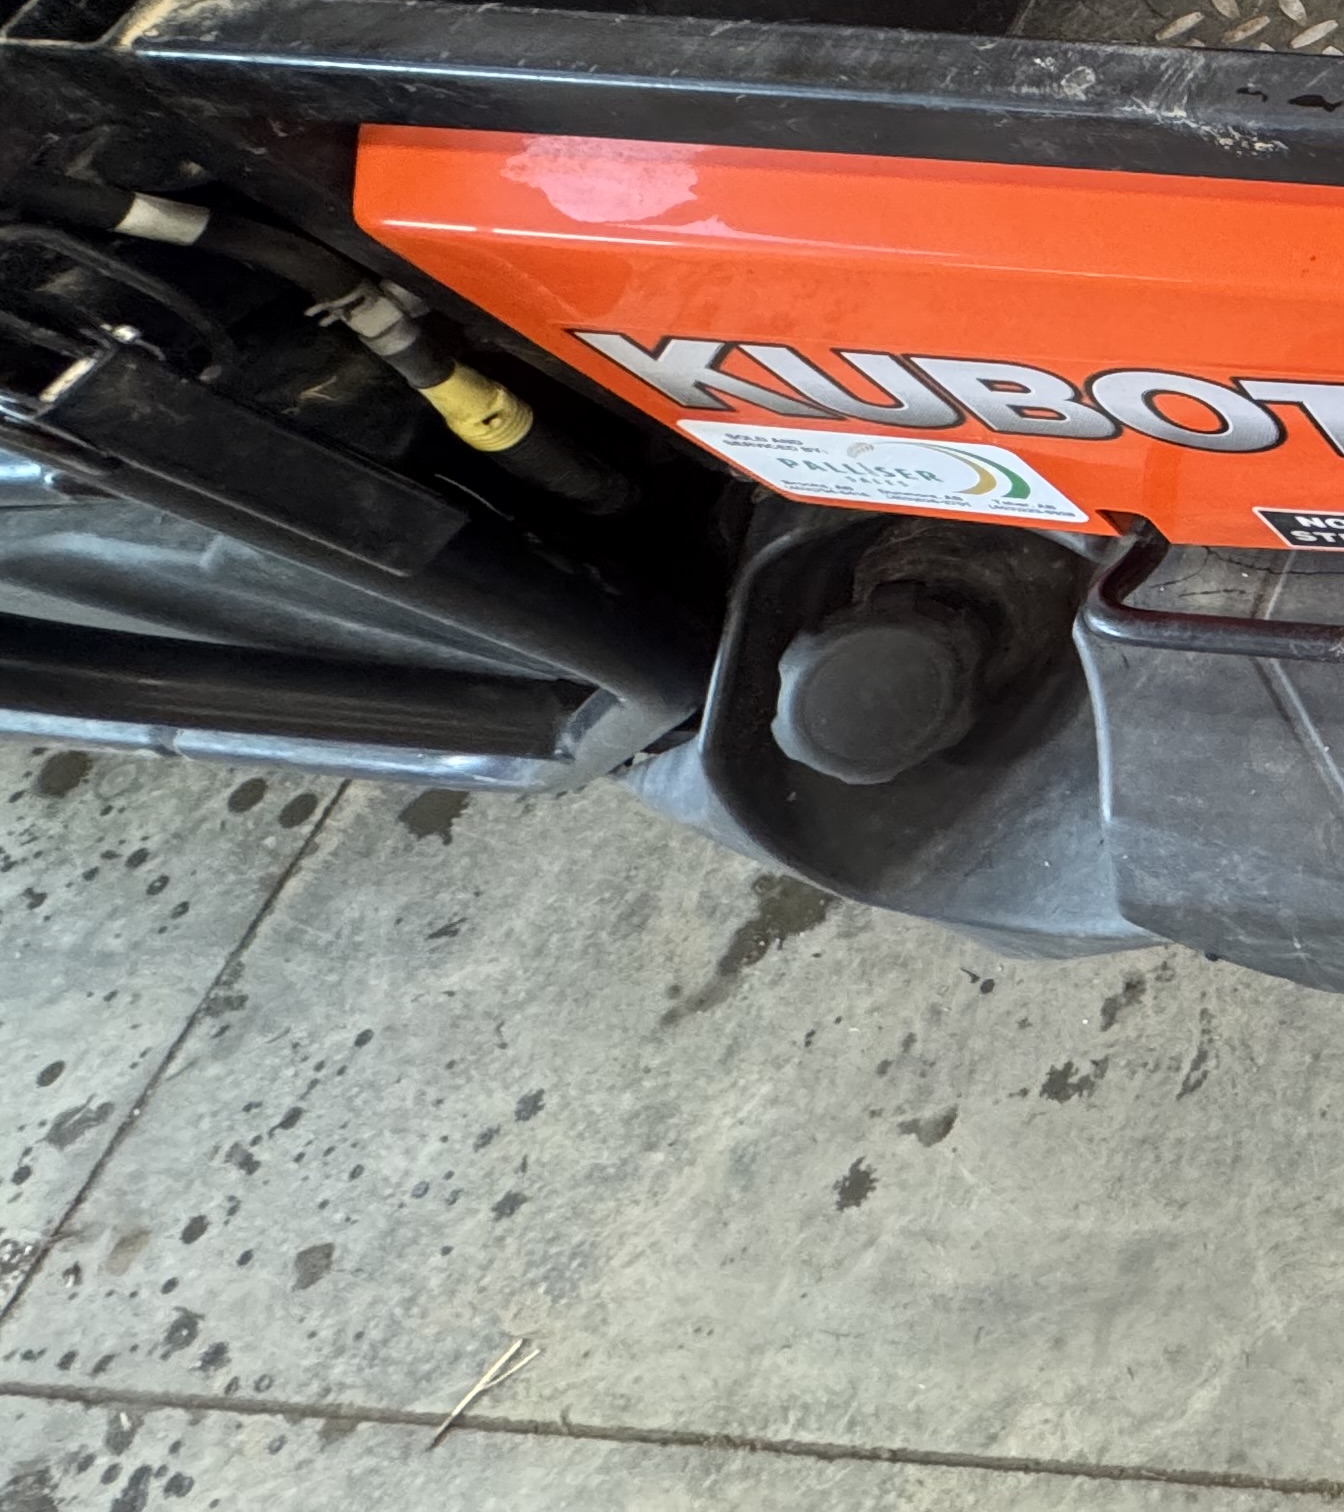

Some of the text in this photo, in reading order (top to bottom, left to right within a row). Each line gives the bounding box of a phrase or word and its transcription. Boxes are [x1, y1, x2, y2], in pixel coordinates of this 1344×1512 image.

[724, 432, 804, 446] SOLD AND
[776, 457, 945, 483] PALLISER
[845, 475, 909, 487] SALES
